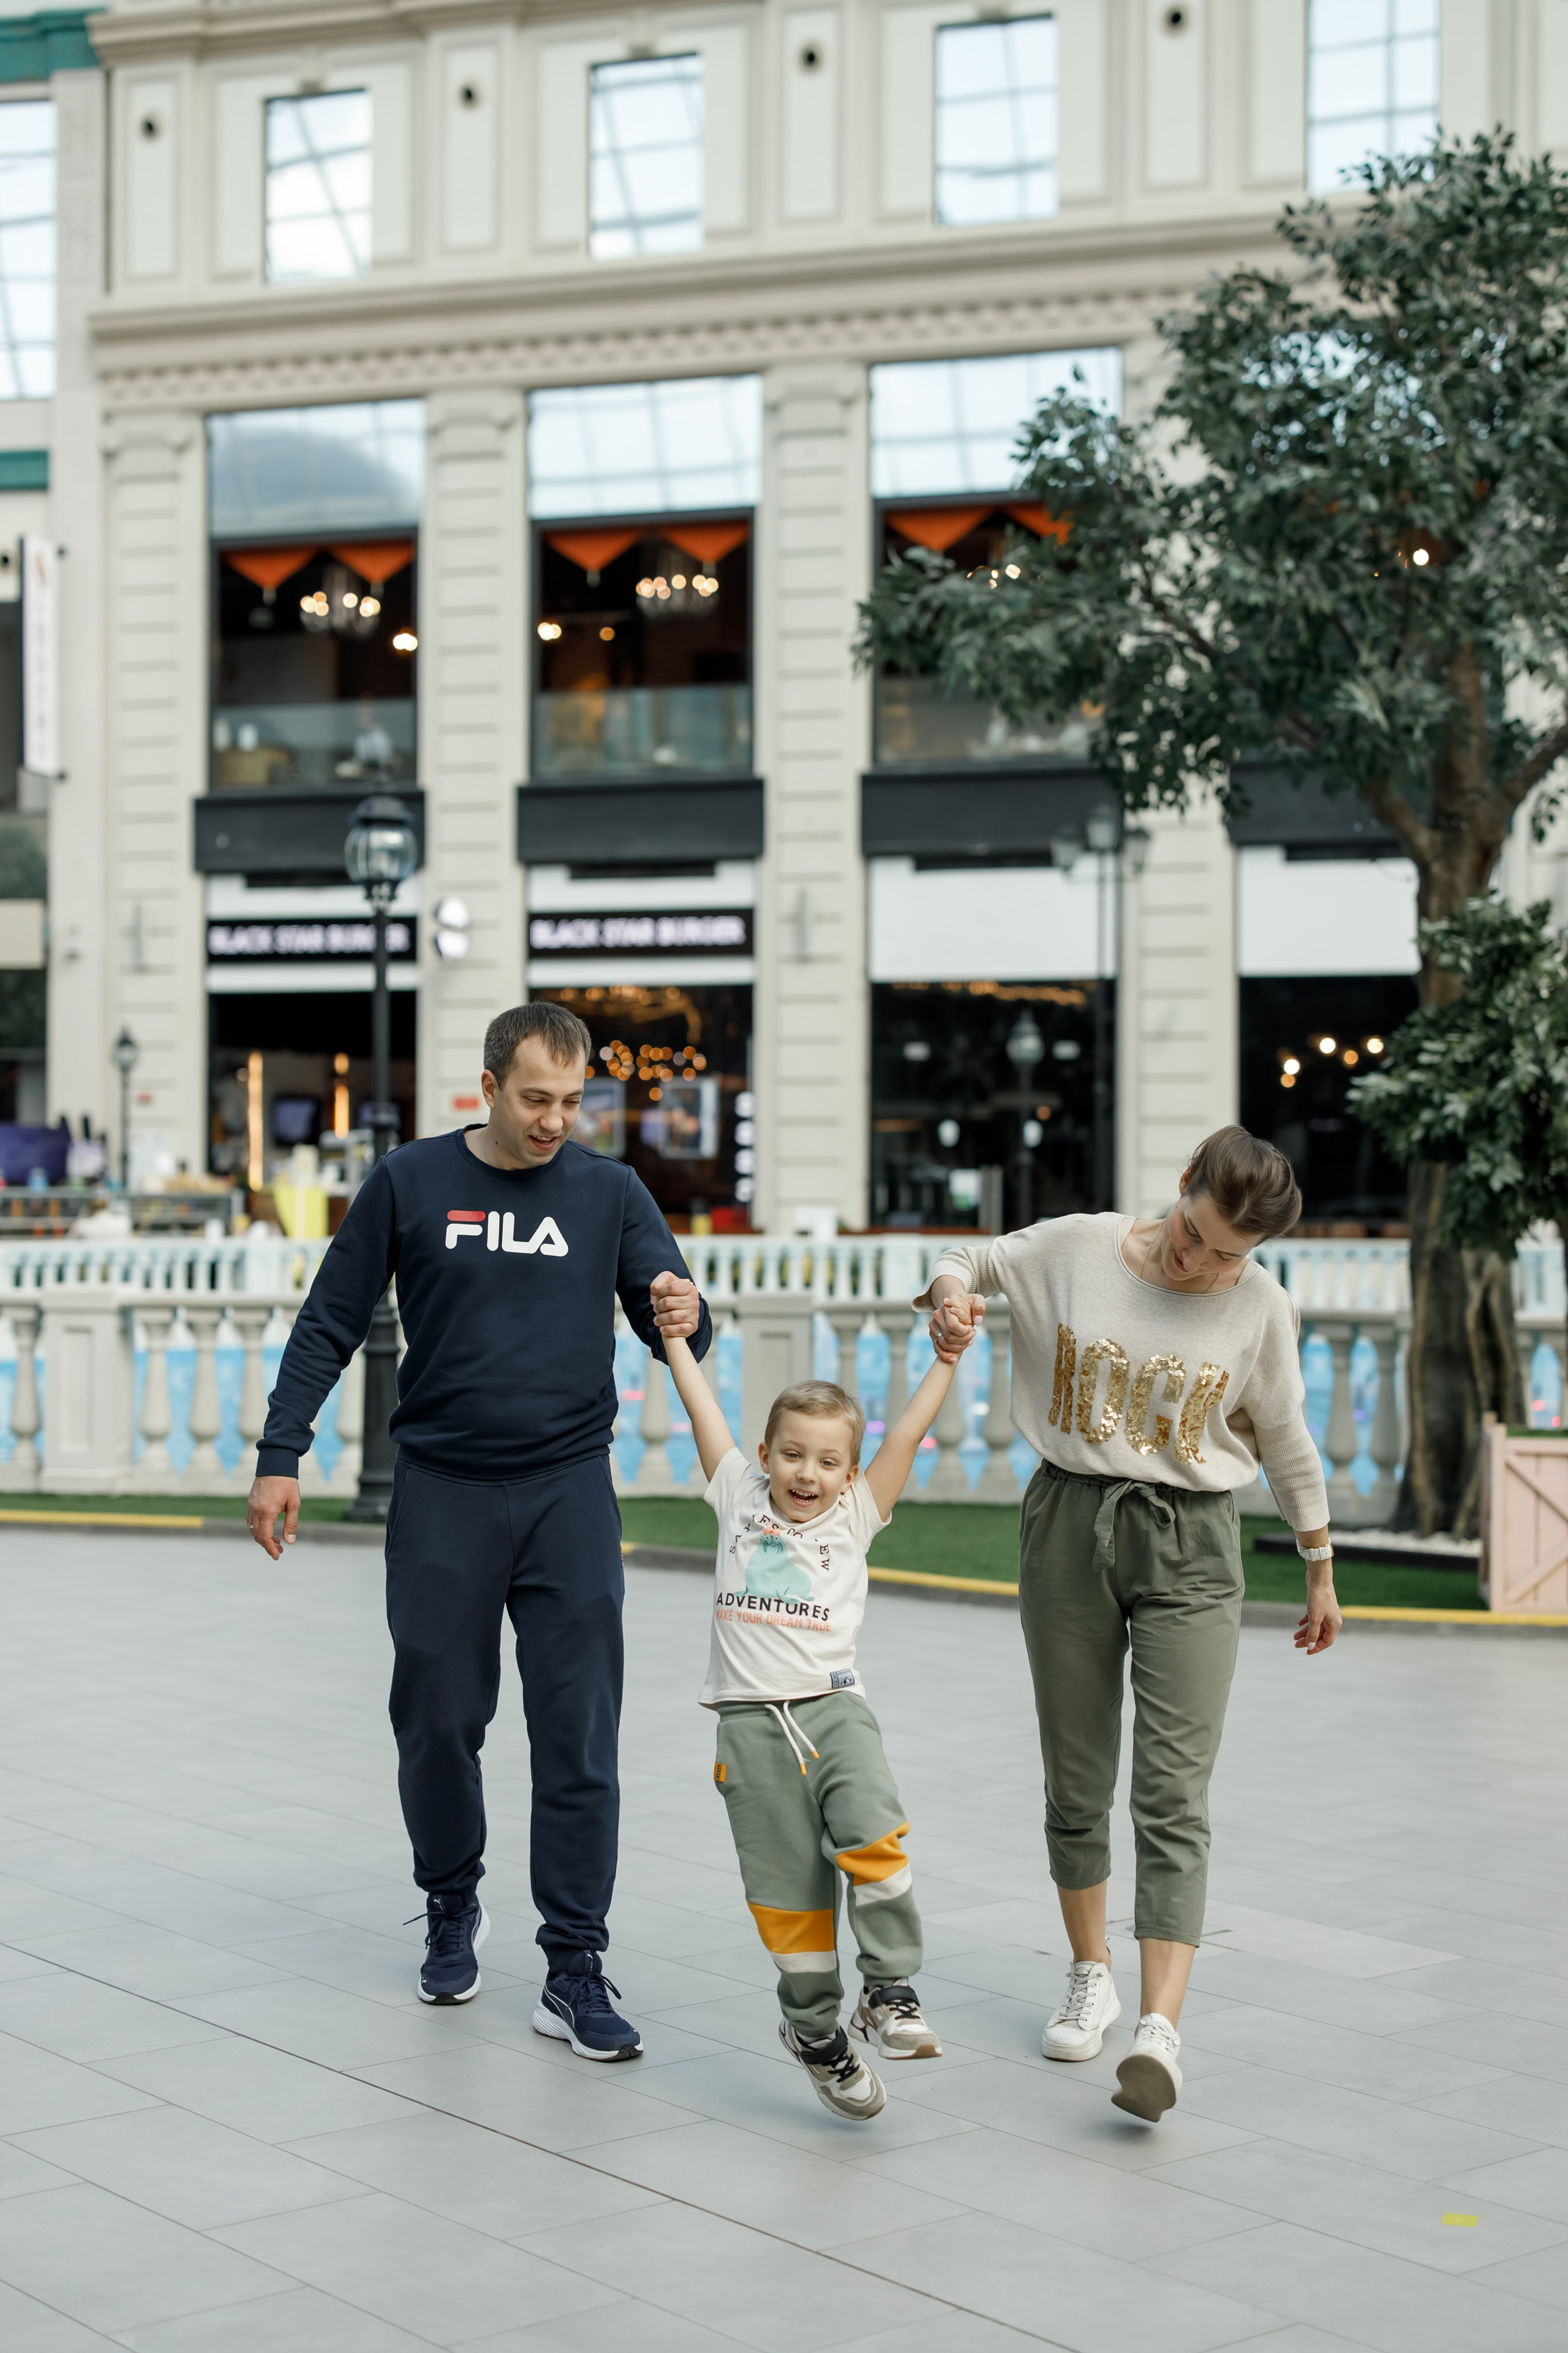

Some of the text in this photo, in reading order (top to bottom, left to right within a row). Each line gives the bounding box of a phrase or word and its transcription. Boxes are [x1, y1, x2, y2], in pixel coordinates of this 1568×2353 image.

[530, 915, 746, 949] BLACK STAR BURGER
[445, 1210, 569, 1256] FILA
[717, 1592, 830, 1622] ADVENTURES
[717, 1609, 831, 1632] MAKE YOUR DREAM TRUE
